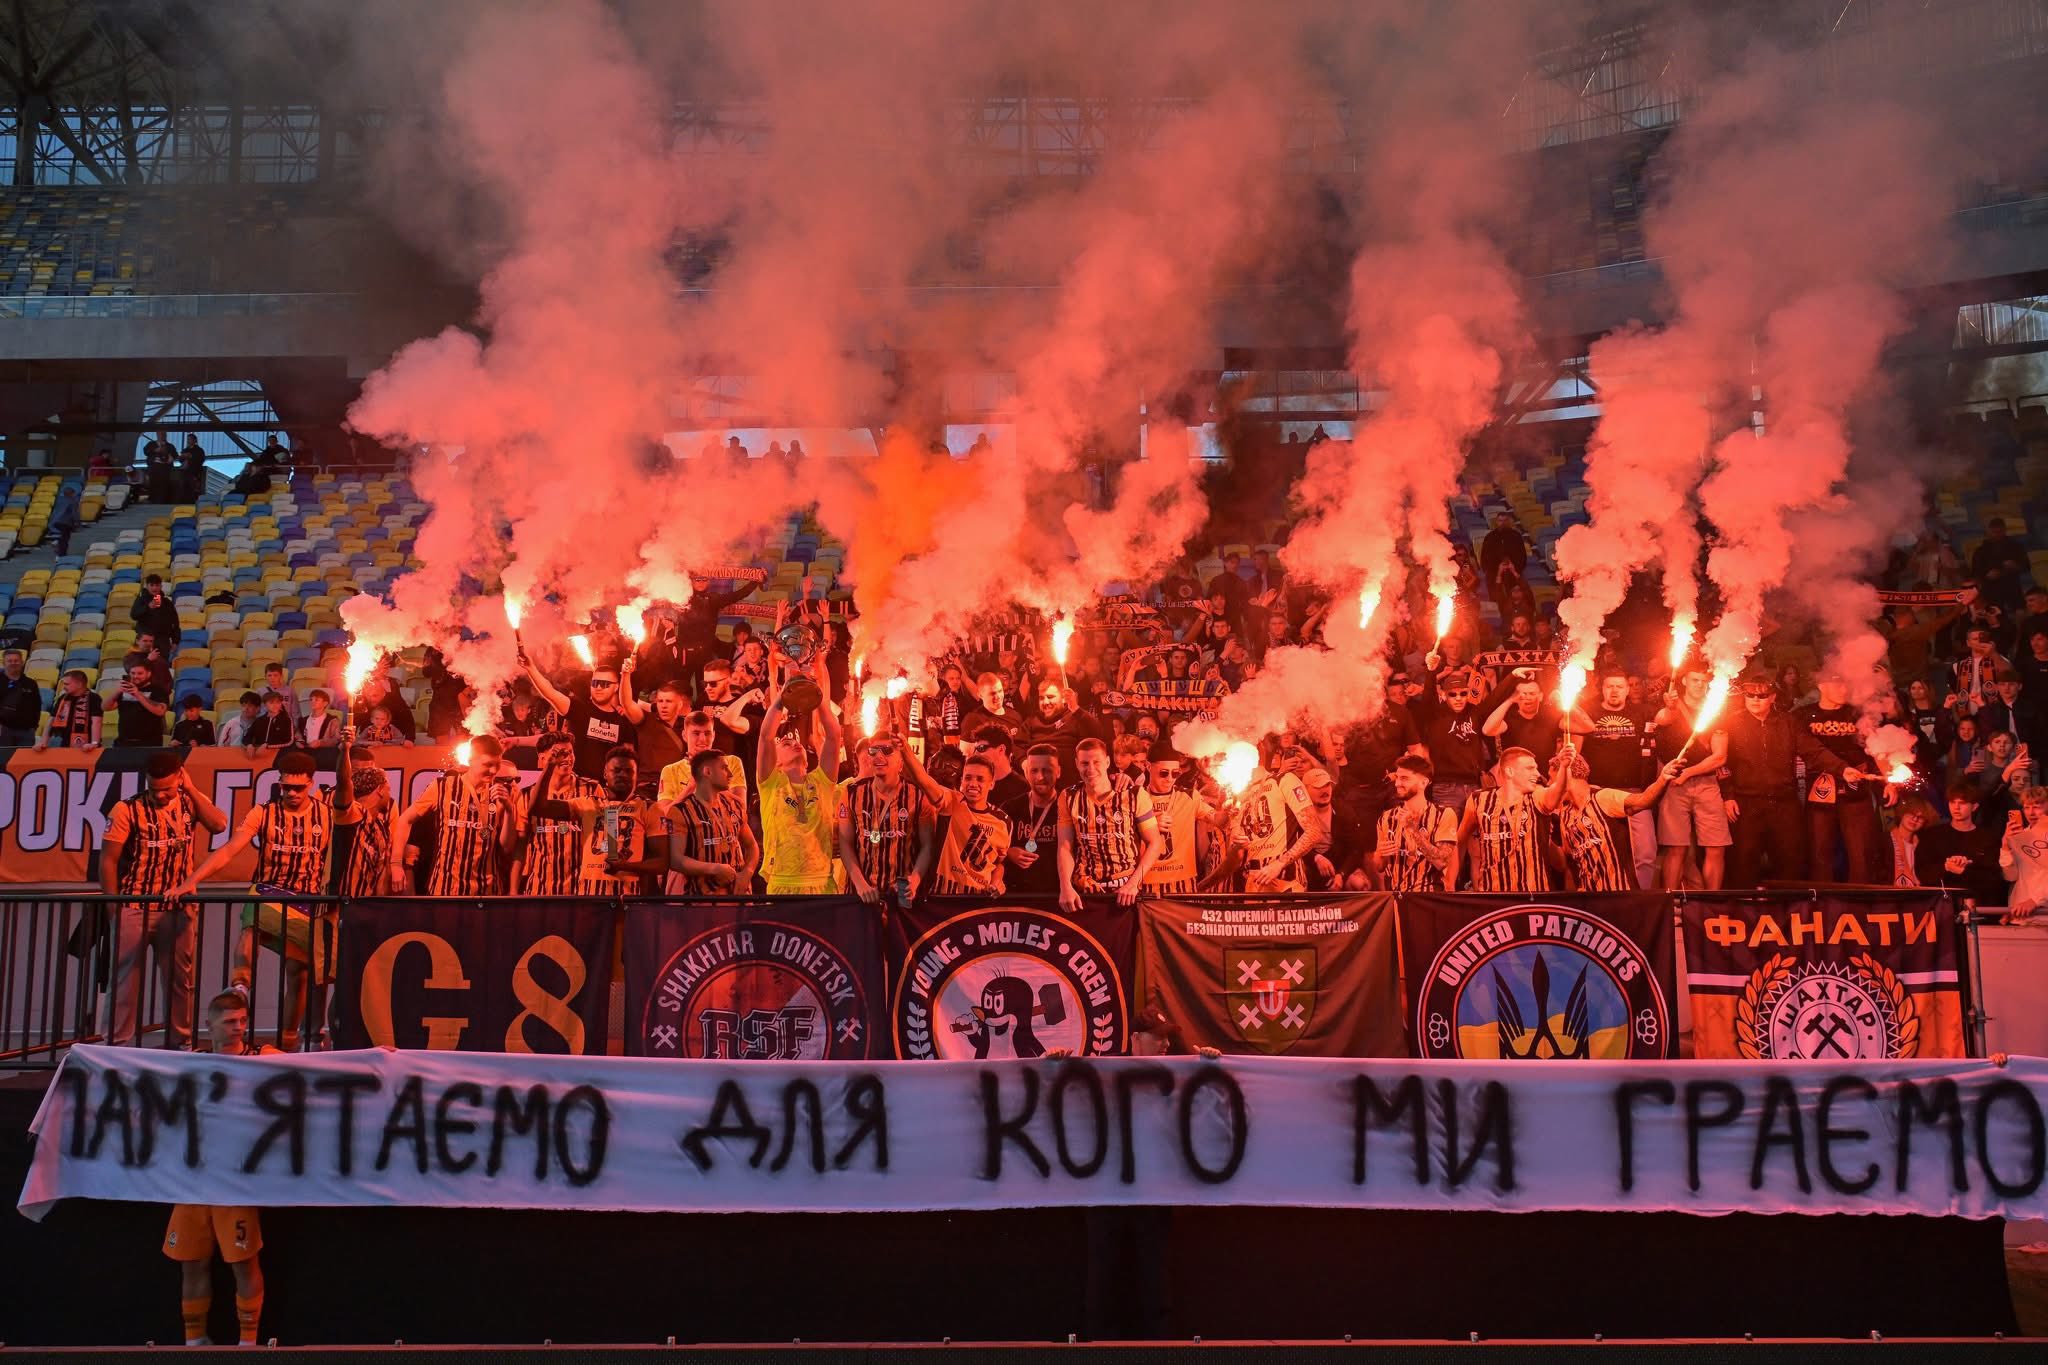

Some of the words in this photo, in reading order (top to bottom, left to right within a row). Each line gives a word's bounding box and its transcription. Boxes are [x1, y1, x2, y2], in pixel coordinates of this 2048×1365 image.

[1484, 652, 1556, 665] ШАХТА
[1131, 694, 1218, 712] SHAKHTA
[536, 822, 583, 833] BETN
[1186, 922, 1260, 937] БЕЗПІЛОТНИХ
[1261, 922, 1305, 936] СИСТЕМ
[1202, 910, 1223, 922] 432
[1224, 908, 1275, 923] ОКРЕМИЙ
[1277, 906, 1342, 921] БАТАЛЬЙОН
[1703, 911, 1937, 947] ФАНАТИ
[911, 938, 961, 998] YOUNG
[978, 922, 1056, 951] MOLES
[1068, 950, 1112, 1007] CREW
[1438, 920, 1515, 987] UNITED
[1528, 914, 1641, 982] PATRIOTS
[658, 930, 755, 1012] SHAKHTAR
[770, 932, 856, 1006] DONETSK
[1777, 981, 1876, 1030] ШАХТАР
[699, 1006, 816, 1060] RSF
[679, 1078, 889, 1175] ДЛЯ
[978, 1060, 1250, 1186] КОГО
[1351, 1073, 1520, 1193] МИ
[1610, 1073, 2047, 1199] ГРАЄМО
[235, 1220, 247, 1241] 5
